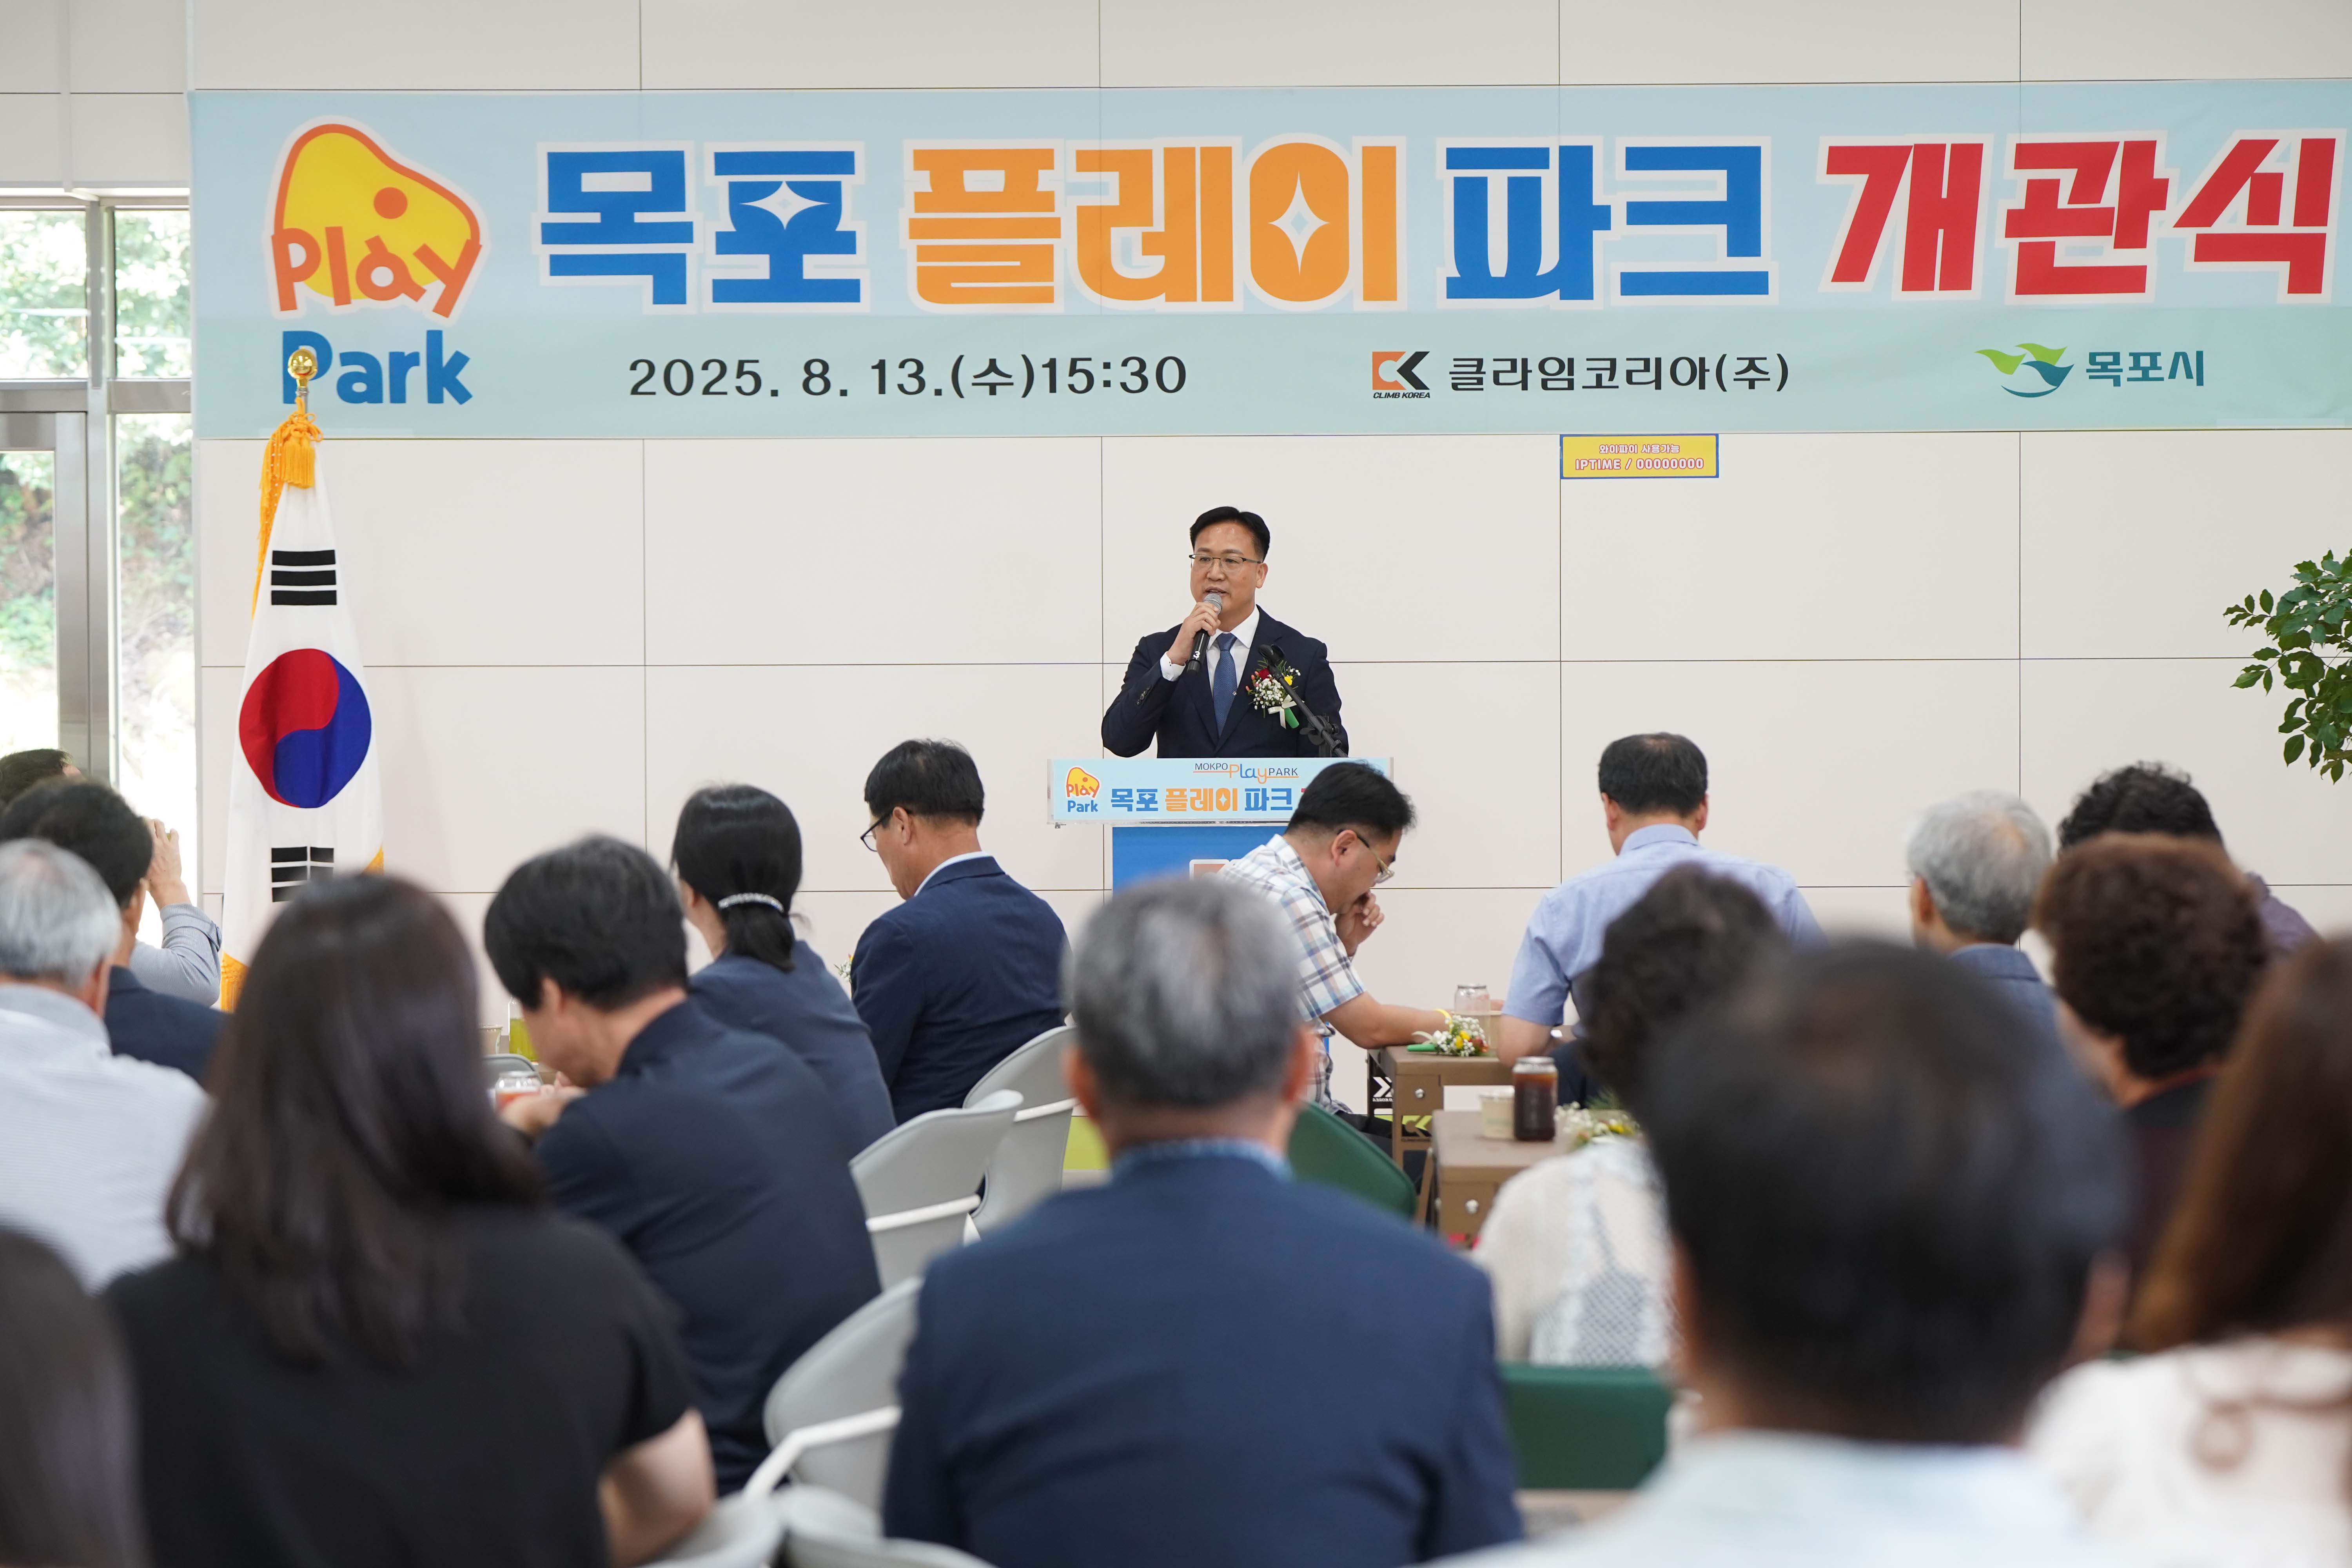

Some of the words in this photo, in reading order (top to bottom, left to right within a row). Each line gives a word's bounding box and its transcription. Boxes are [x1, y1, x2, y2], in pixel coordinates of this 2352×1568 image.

[541, 150, 861, 305] 목포
[909, 142, 1397, 305] 플레이
[1446, 145, 1769, 301] 파크
[1826, 138, 2336, 296] 개관식
[271, 226, 482, 318] Play
[282, 330, 473, 405] Park
[629, 358, 779, 397] 2025.
[801, 358, 849, 397] 8.
[1449, 354, 1789, 392] 클라임코리아(주)
[2086, 350, 2204, 387] 목포시
[1575, 459, 1621, 470] IPTIME
[1636, 458, 1704, 470] 00000000
[1599, 445, 1638, 454] 와이파이
[1641, 444, 1680, 454] 사용가능
[1269, 768, 1298, 776] PARK
[1066, 784, 1098, 798] Play
[1111, 789, 1159, 812] 목포
[1165, 788, 1238, 812] 플레이
[1245, 788, 1293, 811] 파크
[1067, 800, 1098, 813] Park
